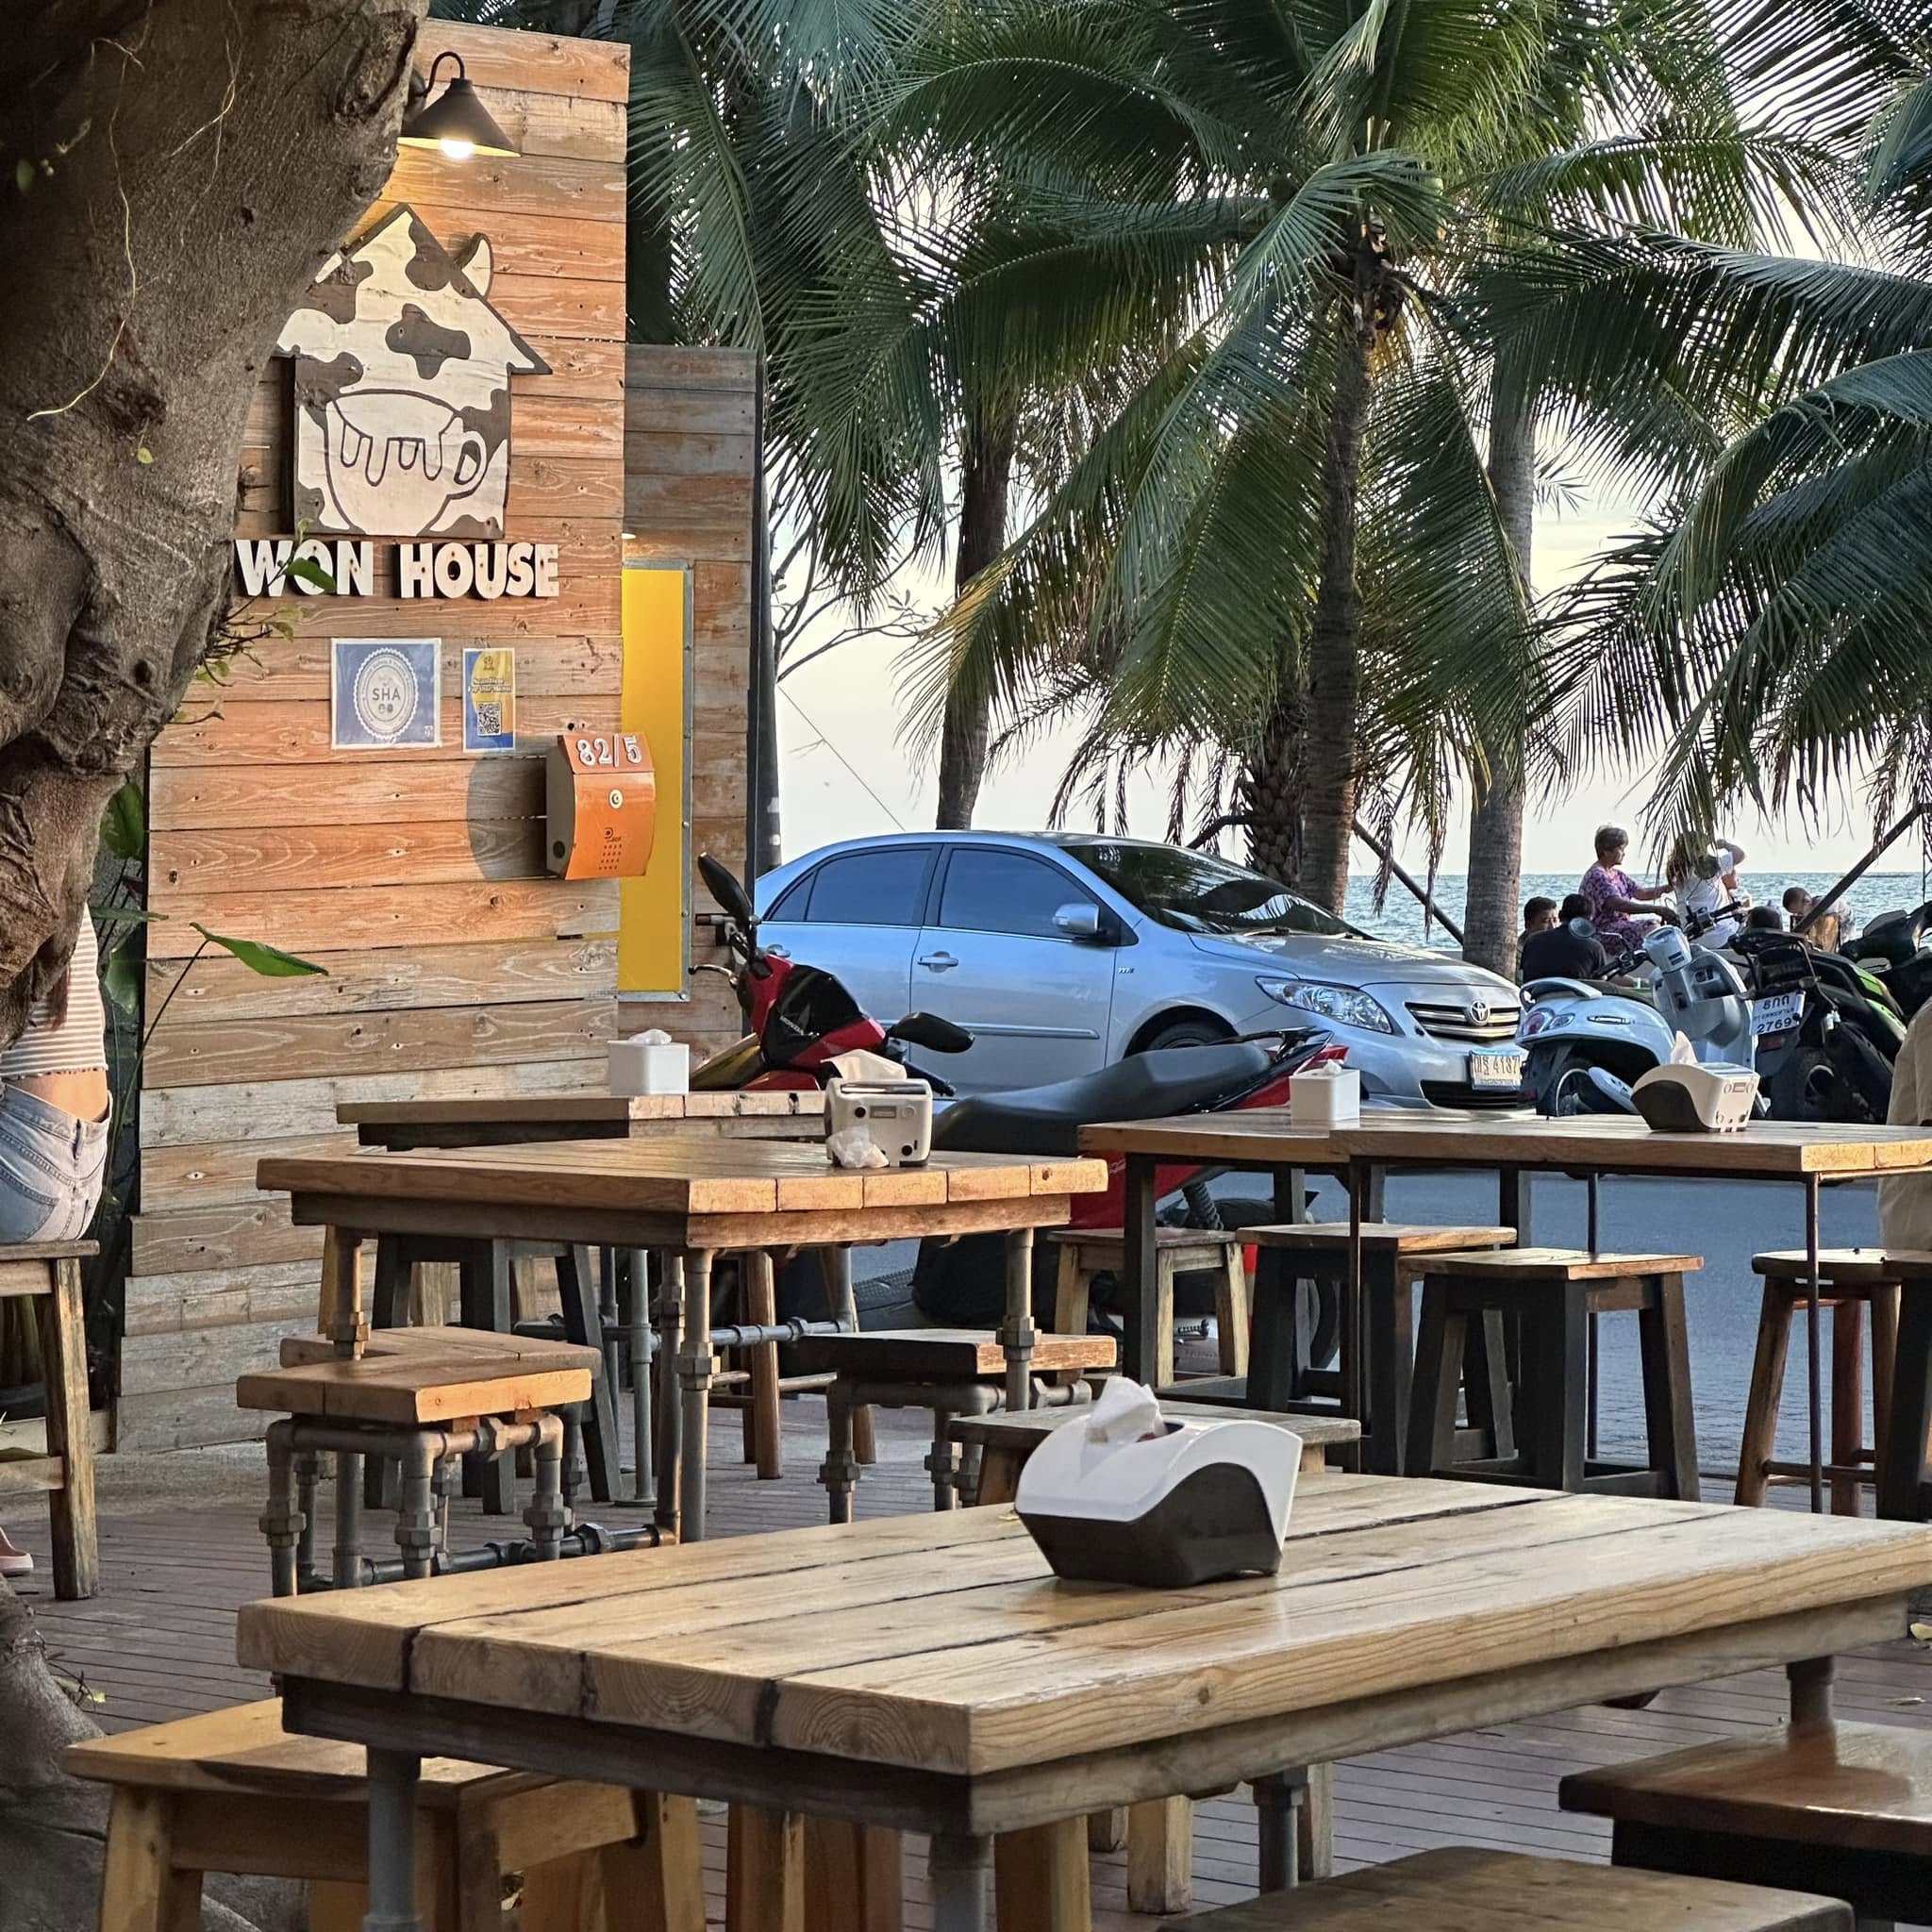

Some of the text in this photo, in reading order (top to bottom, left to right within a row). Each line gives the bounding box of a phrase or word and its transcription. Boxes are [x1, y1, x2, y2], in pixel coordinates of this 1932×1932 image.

[234, 539, 560, 599] WON HOUSE
[372, 688, 401, 701] SHA
[1757, 1017, 1792, 1034] 2769
